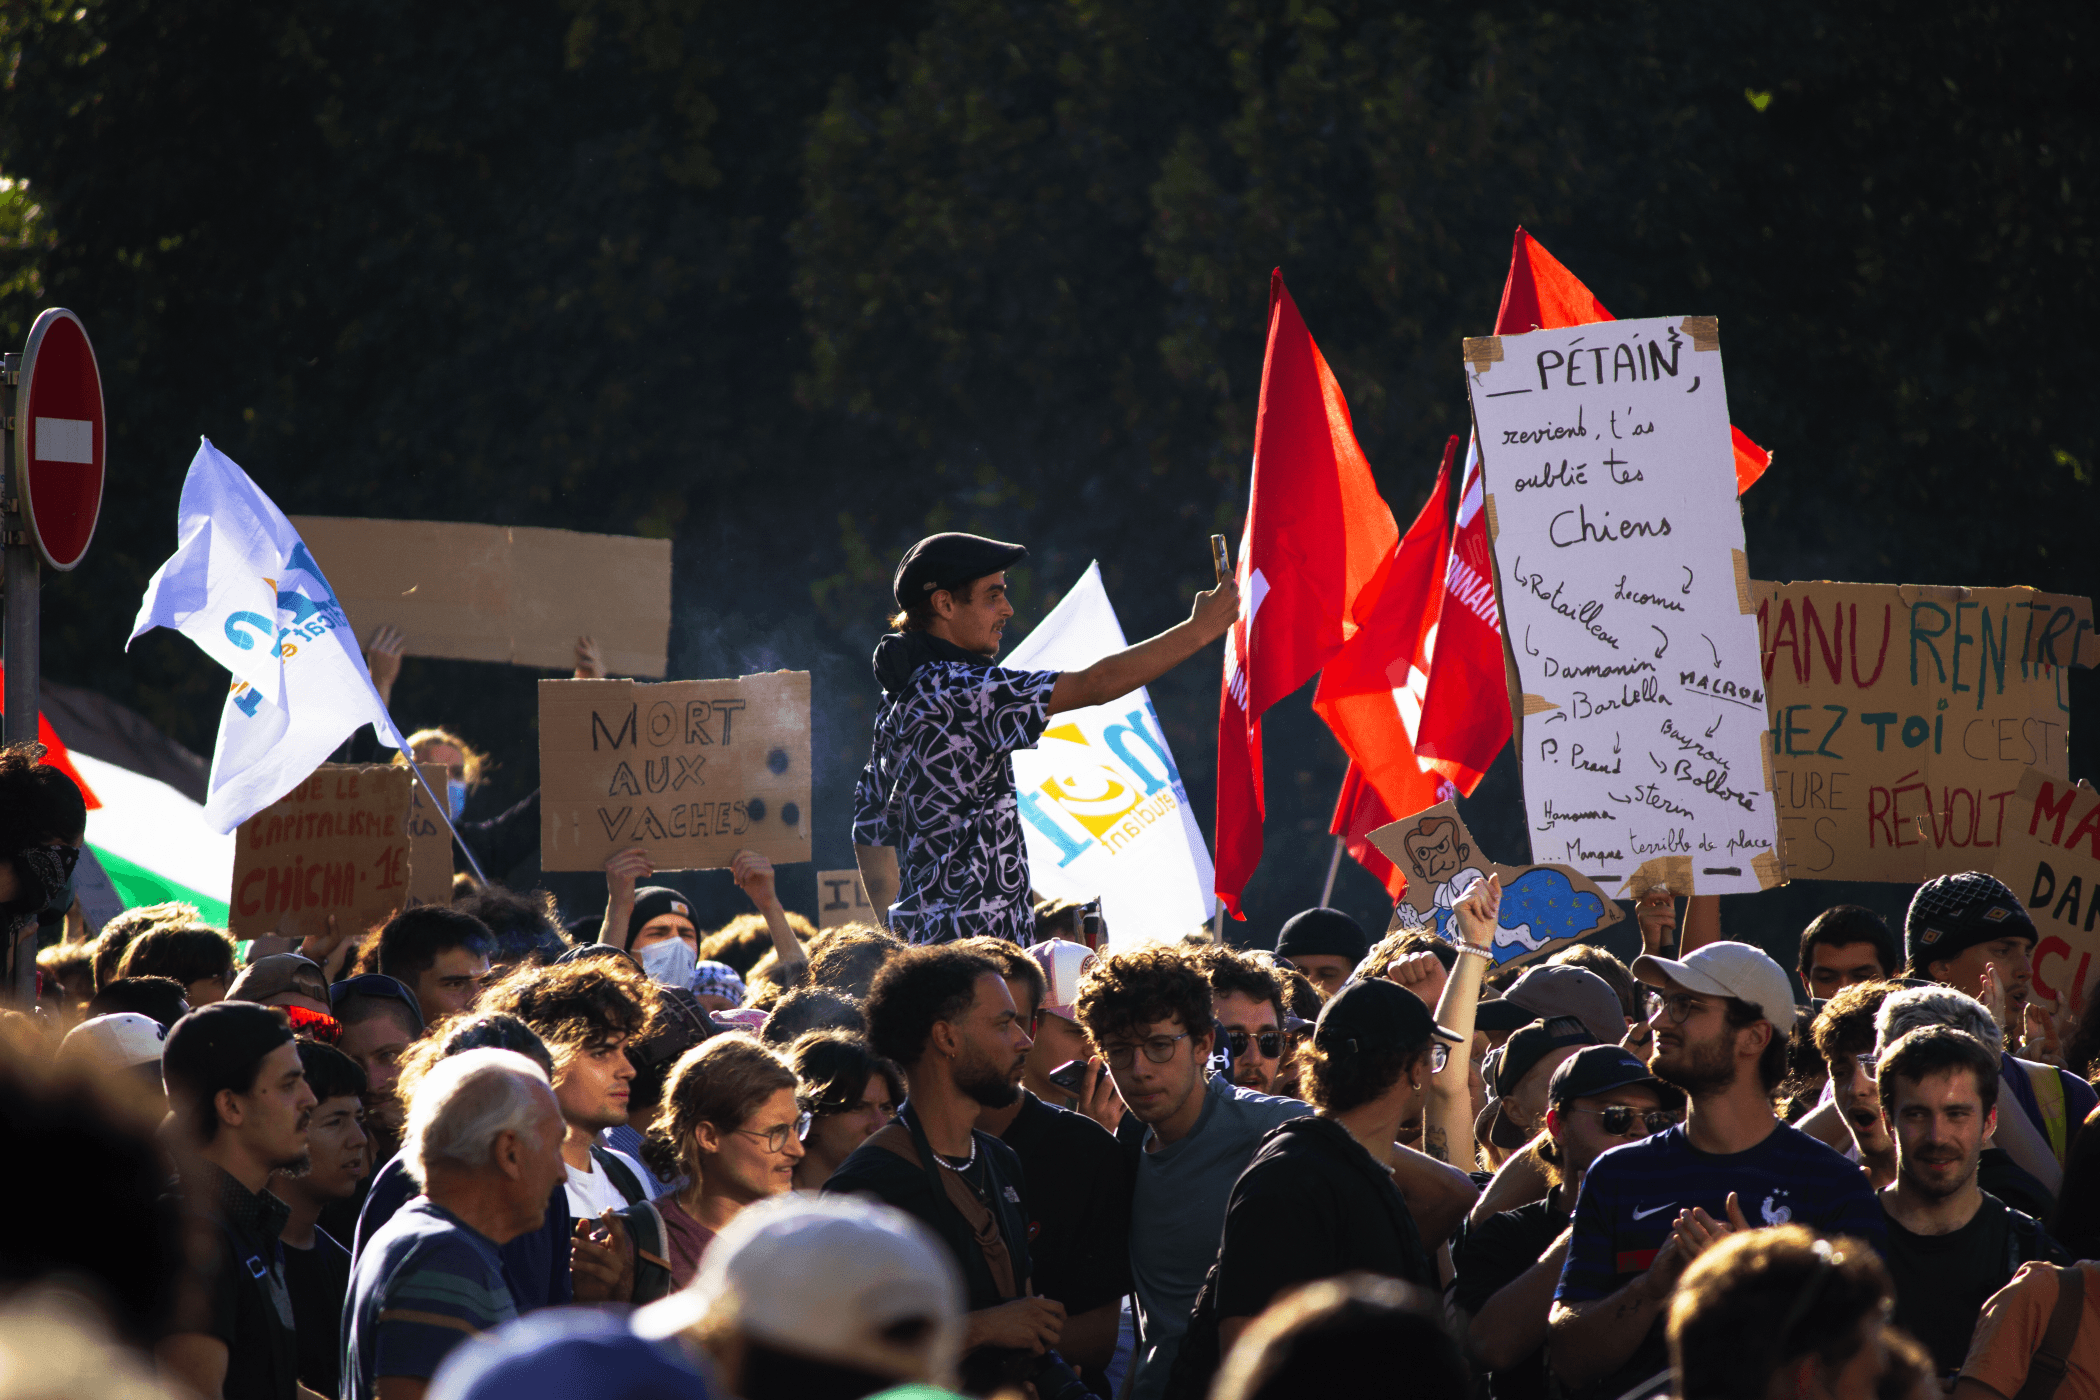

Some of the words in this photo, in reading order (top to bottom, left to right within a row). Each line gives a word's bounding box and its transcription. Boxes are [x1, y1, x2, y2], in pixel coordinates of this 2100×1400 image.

[1514, 459, 1588, 492] oublié
[1602, 448, 1644, 484] tes
[1549, 504, 1671, 547] Chiens
[1679, 671, 1765, 703] MACRON
[592, 698, 746, 751] MORT
[1963, 717, 2061, 765] C'EST
[335, 775, 360, 800] LE
[608, 754, 707, 797] AUX
[598, 799, 750, 841] VACHES
[1629, 828, 1693, 855] terrible
[1726, 829, 1773, 858] place
